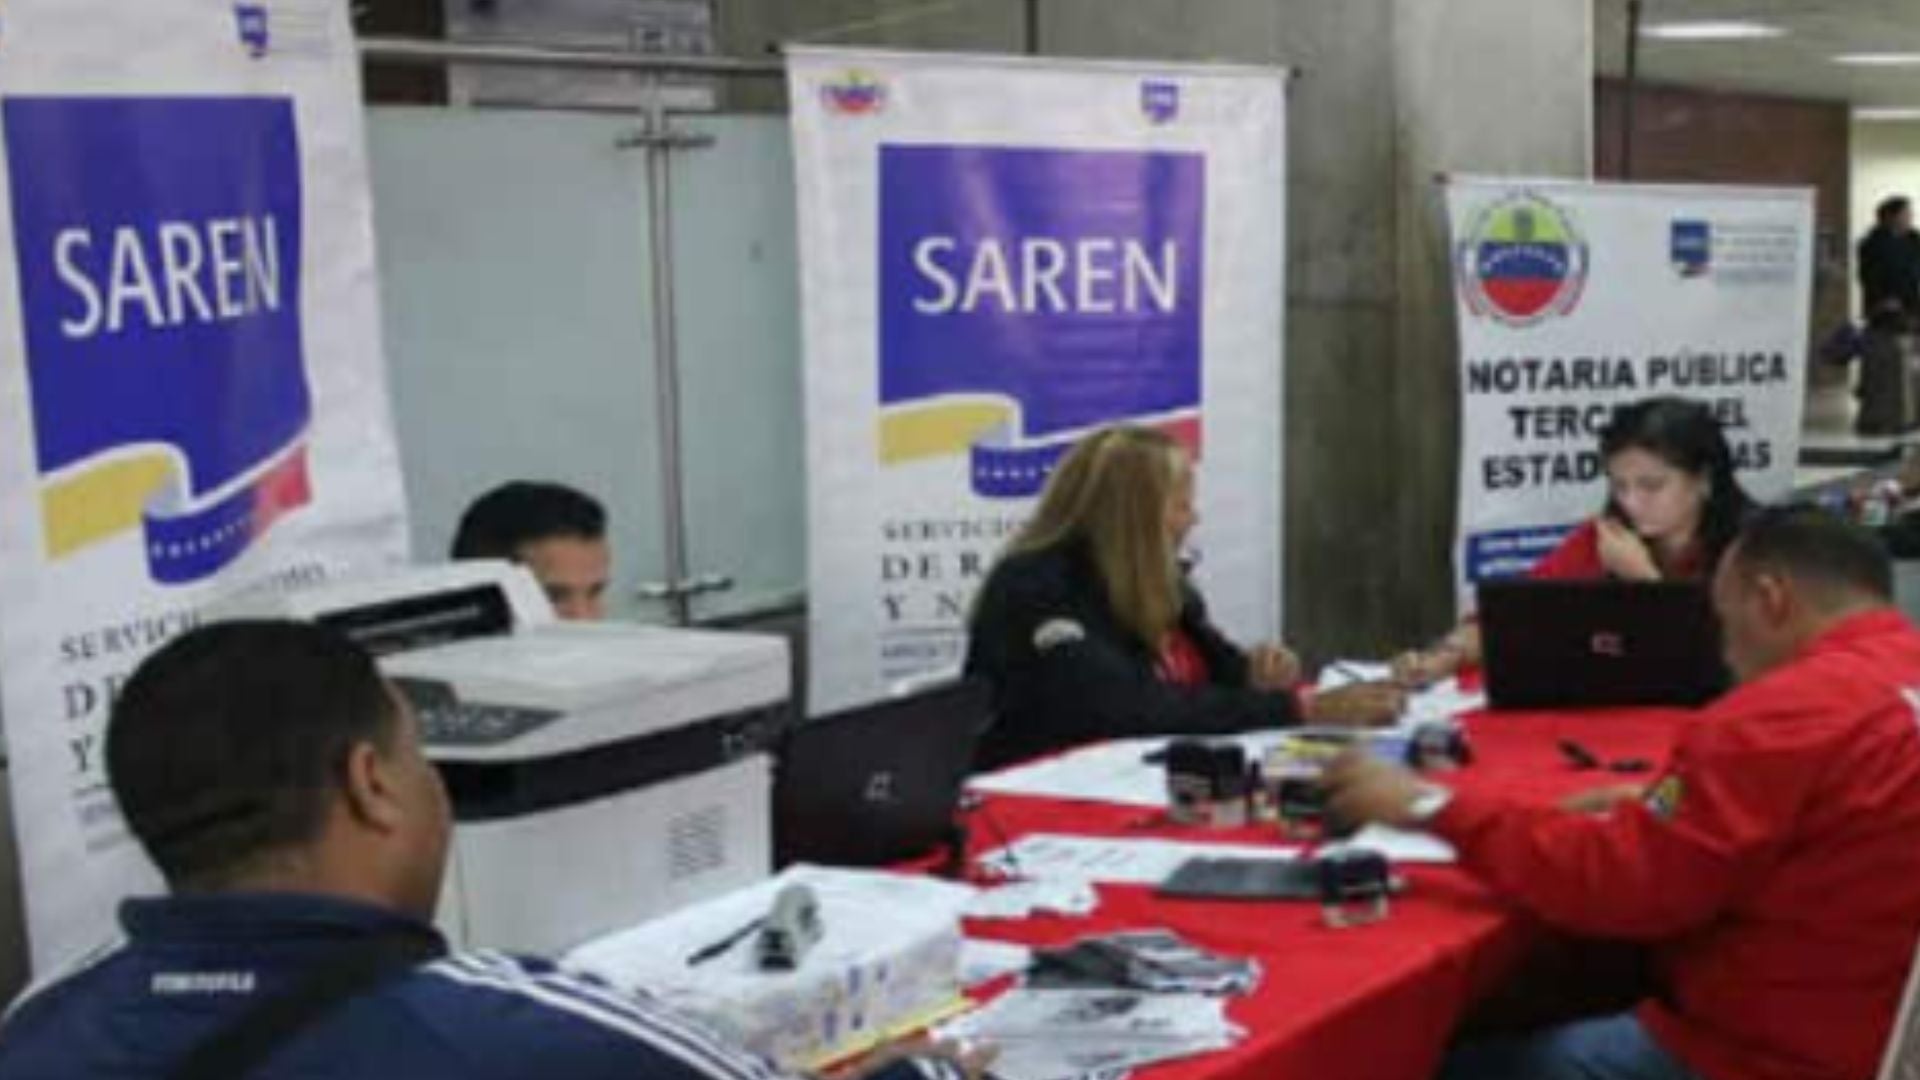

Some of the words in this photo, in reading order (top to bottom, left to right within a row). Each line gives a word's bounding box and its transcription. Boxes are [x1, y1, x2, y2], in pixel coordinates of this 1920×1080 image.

[54, 215, 282, 338] SAREN
[912, 235, 1178, 316] SAREN
[1466, 357, 1637, 393] NOTARIA
[1508, 405, 1606, 441] TERC
[1481, 451, 1602, 491] ESTAD
